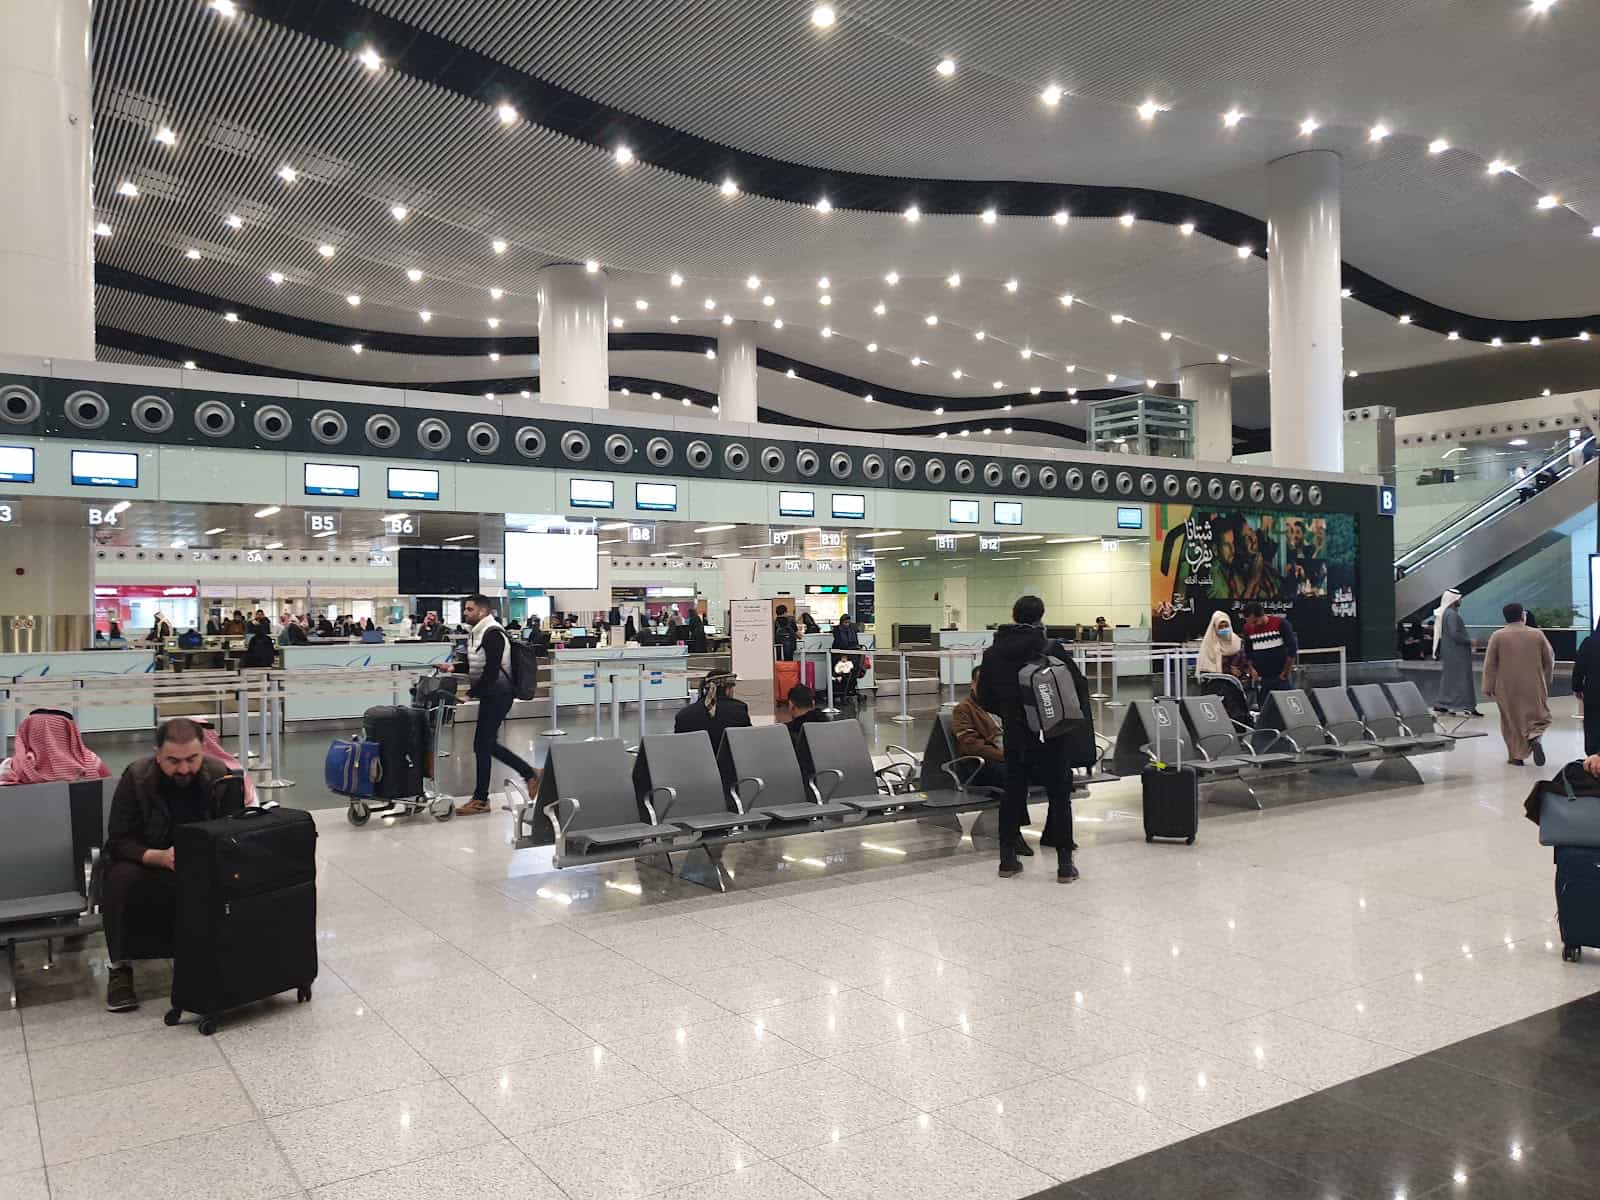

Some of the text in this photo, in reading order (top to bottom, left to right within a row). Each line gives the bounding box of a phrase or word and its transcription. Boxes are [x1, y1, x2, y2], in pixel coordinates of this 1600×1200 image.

[1383, 491, 1392, 509] B
[88, 508, 118, 526] B4
[311, 515, 334, 530] B5
[391, 519, 413, 534] B6
[632, 527, 651, 541] B8
[773, 532, 788, 545] B9
[821, 533, 840, 546] B10
[938, 535, 954, 549] B11
[981, 538, 998, 550] B12
[1045, 707, 1055, 719] LEE
